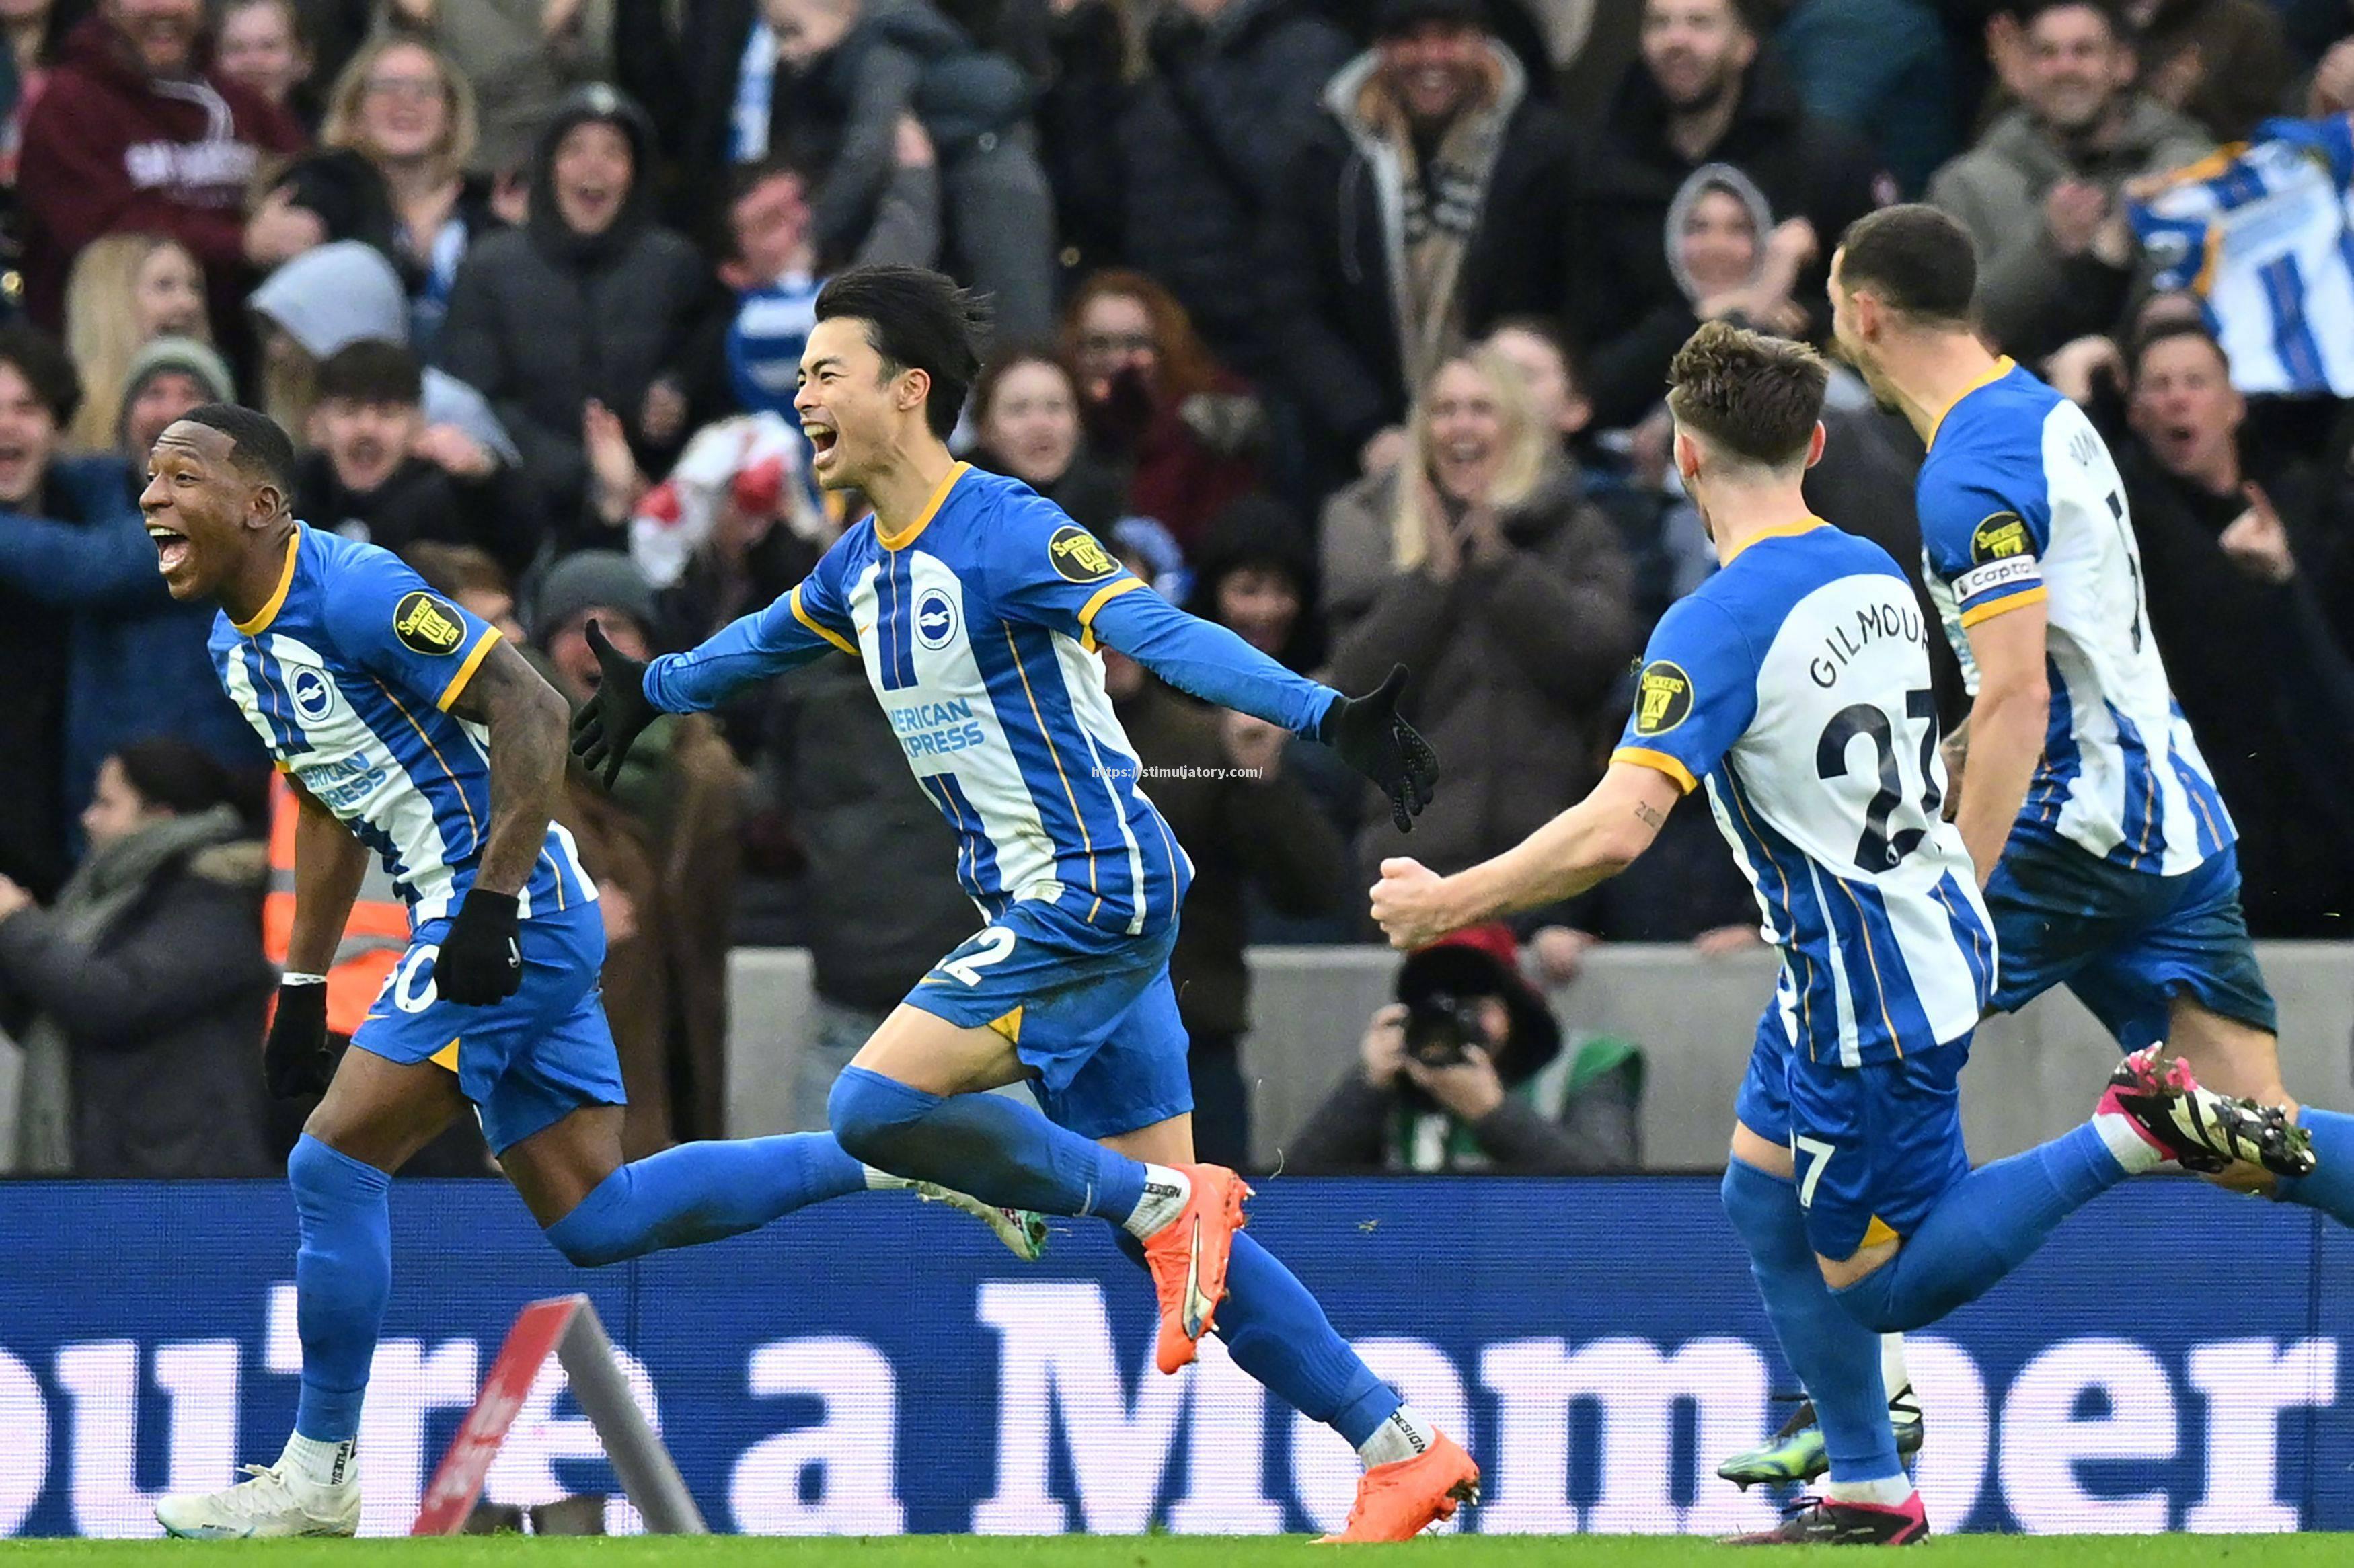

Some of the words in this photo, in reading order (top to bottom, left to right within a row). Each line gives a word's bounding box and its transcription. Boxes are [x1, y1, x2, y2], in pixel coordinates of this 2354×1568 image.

[420, 611, 449, 641] UK
[891, 697, 973, 732] ERICAN
[1816, 688, 1941, 873] 27
[935, 926, 1016, 987] 2
[1790, 1126, 1835, 1208] 7
[728, 1333, 907, 1536] a
[1390, 1411, 1425, 1453] DESIGN
